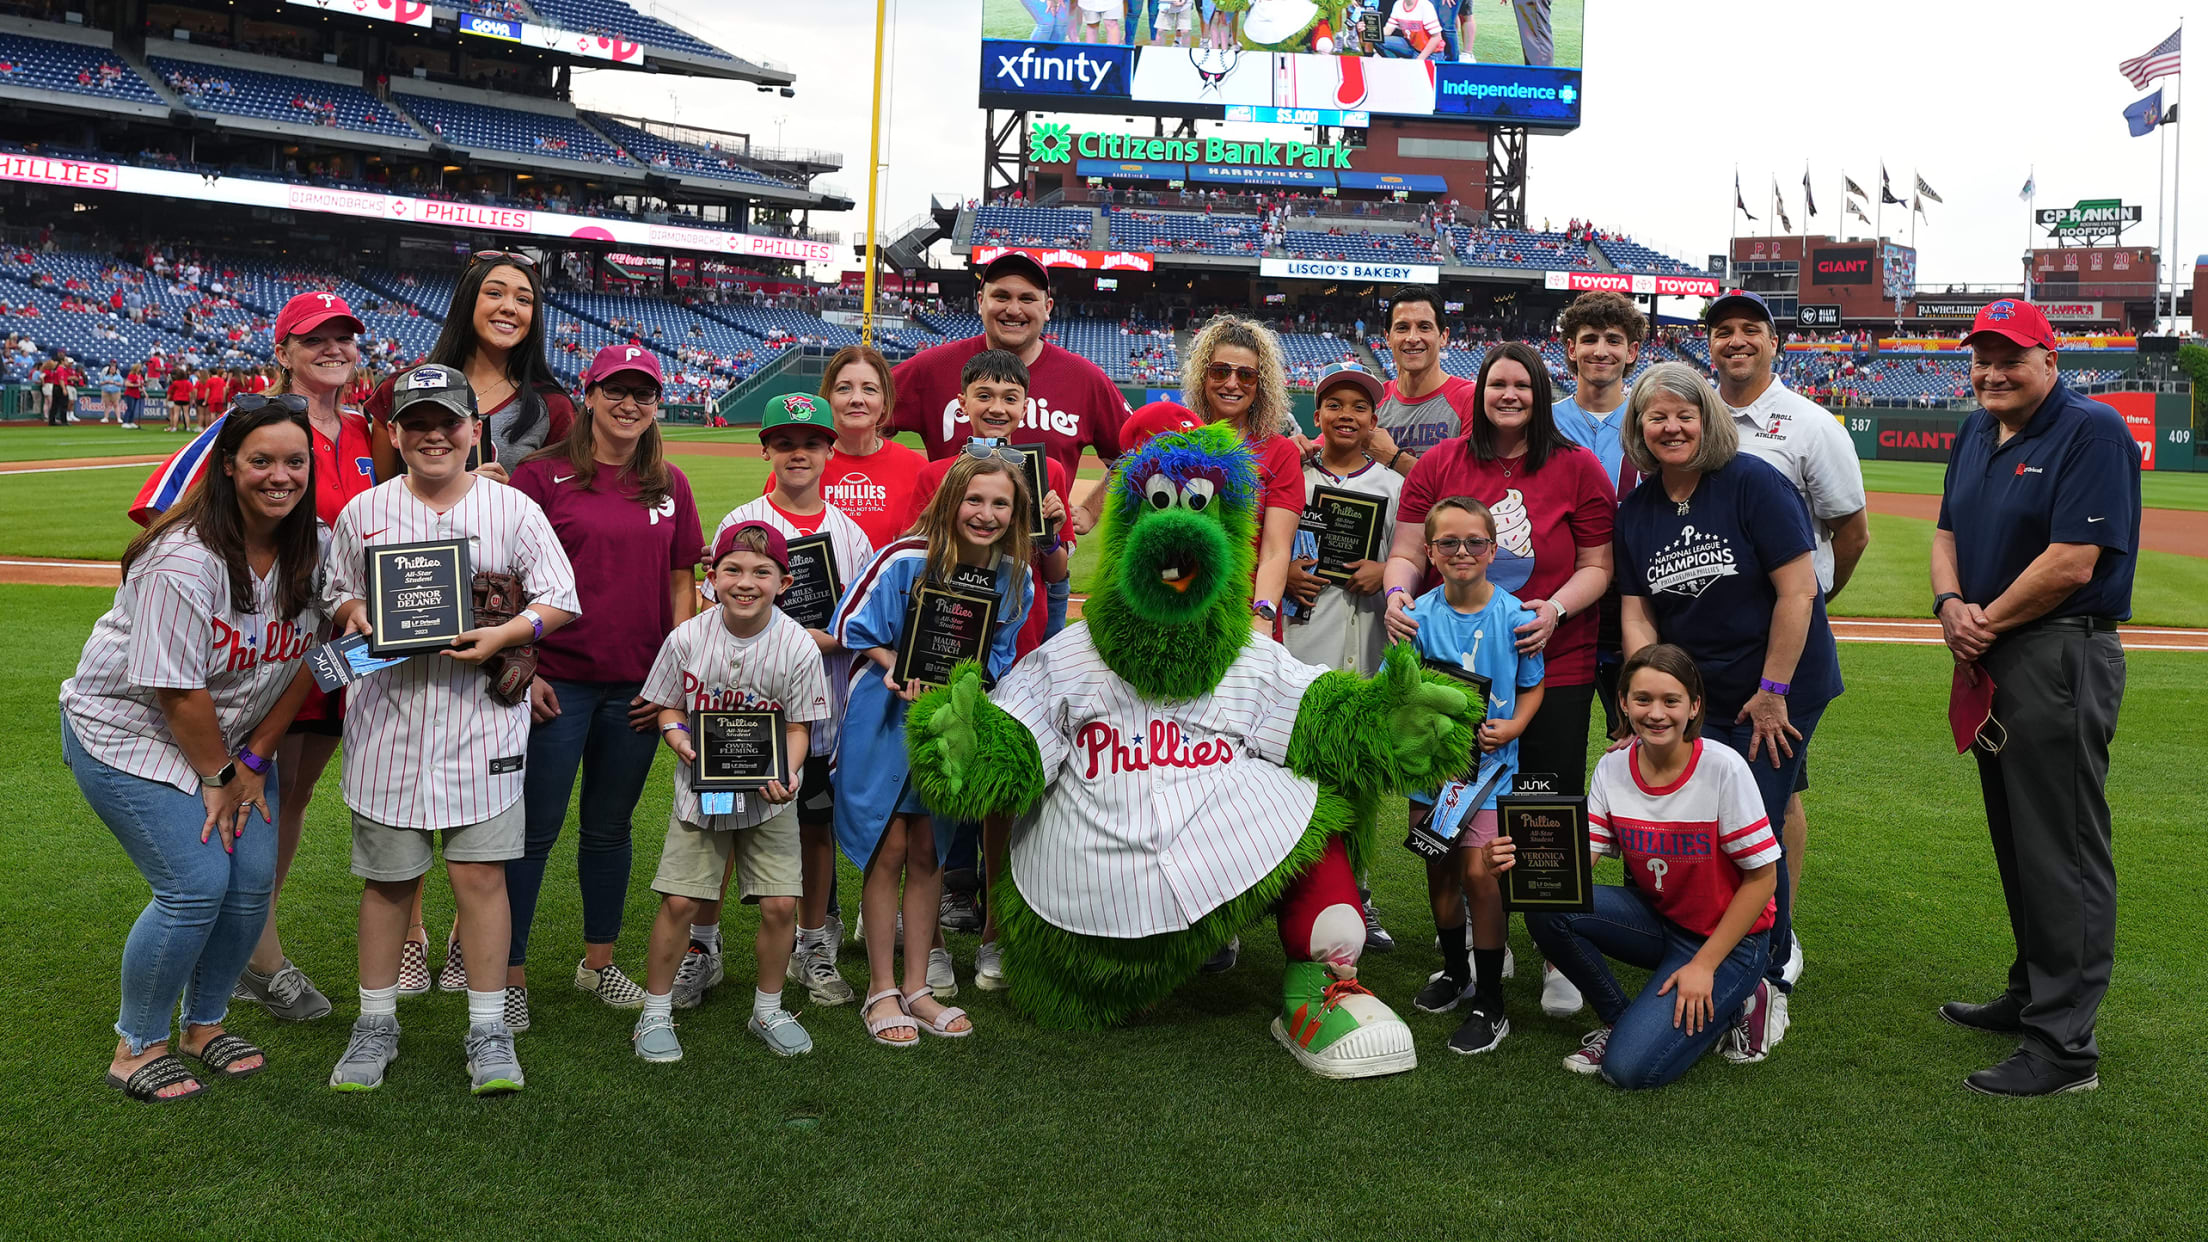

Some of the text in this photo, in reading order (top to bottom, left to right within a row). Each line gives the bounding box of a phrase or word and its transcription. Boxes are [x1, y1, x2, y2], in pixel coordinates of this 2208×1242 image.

[471, 18, 511, 36] GOYA
[997, 50, 1114, 90] xfinity
[1443, 79, 1556, 101] Independence
[1276, 108, 1319, 124] $5,000
[1078, 131, 1353, 169] Citizens Bank Park
[0, 157, 109, 184] HILLIES
[1208, 167, 1263, 177] HARRY
[292, 191, 526, 227] DIAMONDBACKS PHILLIES
[2043, 207, 2133, 222] CP RANKIN
[2059, 226, 2116, 237] ROOFTOP
[752, 239, 830, 259] PHILLIES
[1059, 249, 1088, 269] BEAM
[1101, 252, 1150, 272] JIM BEAM
[2065, 253, 2078, 266] 14
[2114, 252, 2130, 265] 20
[1287, 263, 1411, 279] LISCIO'S BAKERY
[1817, 260, 1868, 273] GIANT
[1572, 276, 1629, 290] TOYOTA
[1659, 279, 1716, 295] TOYOTA
[316, 293, 336, 308] P
[625, 348, 642, 362] P
[1851, 418, 1871, 433] 387
[2126, 415, 2151, 425] there.
[1879, 431, 1957, 451] GIANT
[2169, 430, 2191, 444] 409
[824, 485, 886, 500] PHILLIES
[832, 499, 887, 507] ASEBALL
[1331, 502, 1363, 519] Phillies
[1324, 533, 1360, 545] JEREMIAH
[1681, 525, 1695, 546] P
[1328, 540, 1354, 551] SCATES
[1655, 541, 1721, 565] NATIONAL LEAGUE
[394, 556, 441, 570] Phillies
[1646, 548, 1735, 583] CHAMPIONS
[404, 576, 433, 584] Student
[405, 570, 433, 578] All-Star
[958, 571, 990, 587] JUNK
[1660, 570, 1697, 587] PHILADELPHIA
[397, 590, 441, 601] CONNOR
[781, 590, 831, 607] ARKO-BELTLE
[791, 586, 814, 598] MILES
[397, 596, 442, 608] DELANEY
[935, 598, 974, 618] Phillies
[208, 615, 314, 673] Phillie
[931, 642, 961, 655] LYNCH
[932, 635, 962, 648] MAURA
[313, 652, 338, 682] JUNK
[717, 717, 759, 728] Phillies
[1076, 719, 1234, 780] Phillies
[1518, 780, 1551, 791] JUNK
[1521, 813, 1561, 828] Phillies
[1411, 837, 1440, 857] JUNK
[1521, 852, 1565, 861] VERONICA
[1528, 859, 1560, 868] ZADNIK
[1646, 858, 1669, 889] P
